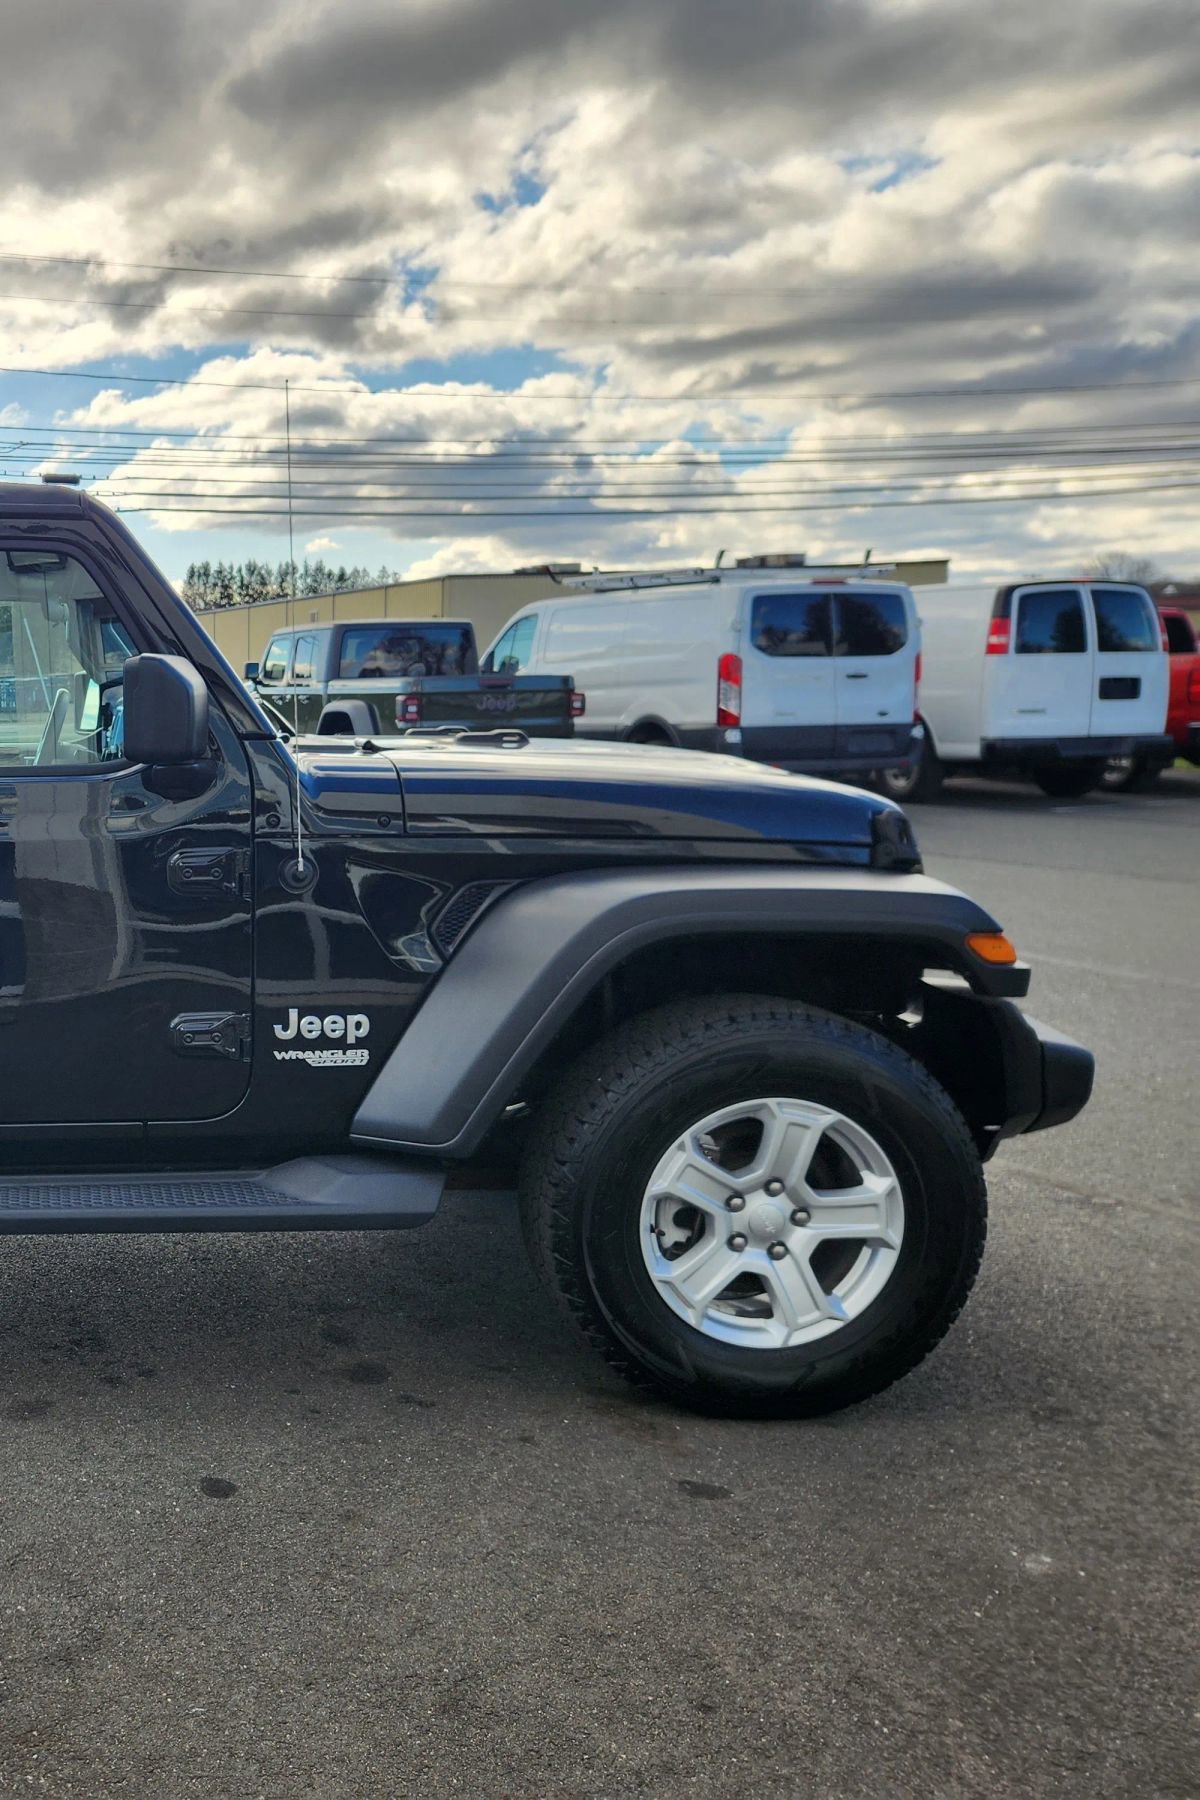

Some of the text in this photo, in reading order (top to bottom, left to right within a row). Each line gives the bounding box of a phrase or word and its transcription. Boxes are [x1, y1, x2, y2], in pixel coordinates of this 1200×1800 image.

[273, 1008, 370, 1044] Jeep
[273, 1049, 370, 1060] WRANGLER
[310, 1058, 365, 1066] SPORT
